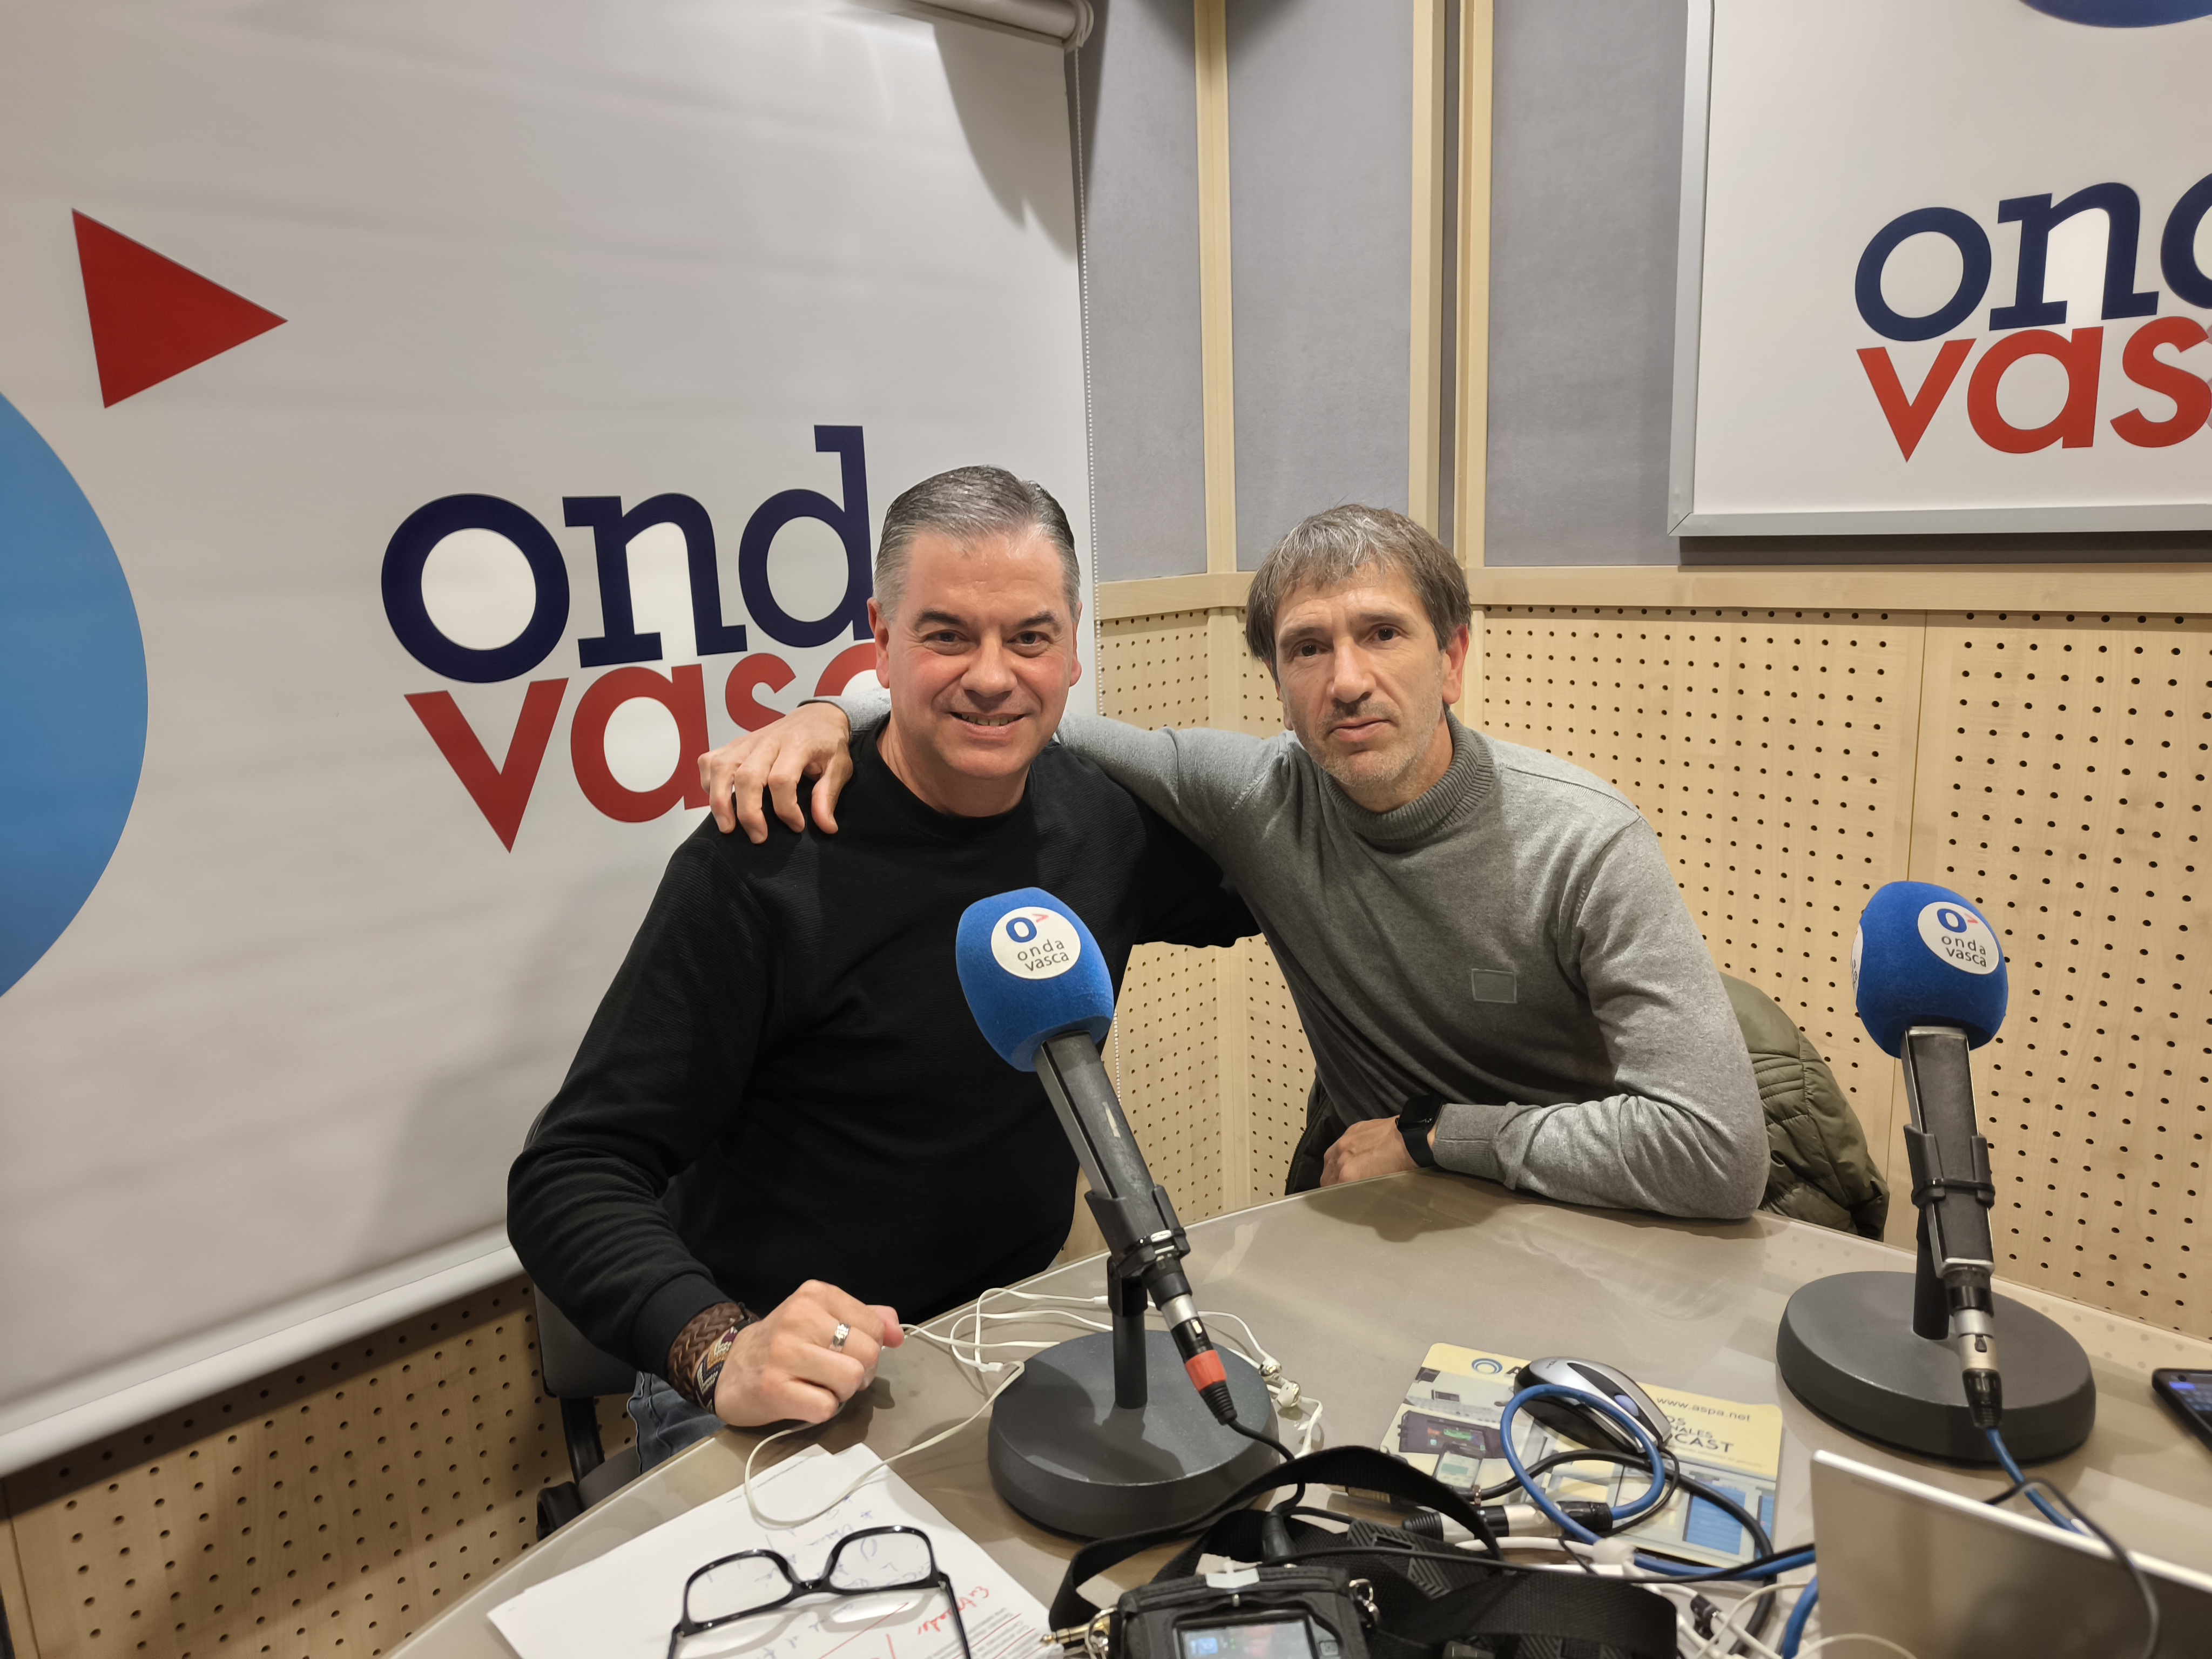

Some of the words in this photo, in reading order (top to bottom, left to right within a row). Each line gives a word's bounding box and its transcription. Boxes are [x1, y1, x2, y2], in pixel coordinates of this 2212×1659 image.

[1857, 316, 2212, 463] vas
[381, 424, 875, 683] ond
[1017, 939, 1064, 961] onda
[1941, 936, 1986, 955] onda
[1025, 952, 1069, 972] vasca
[1946, 947, 1987, 968] vasca
[1656, 1397, 1751, 1422] www.aspa.net
